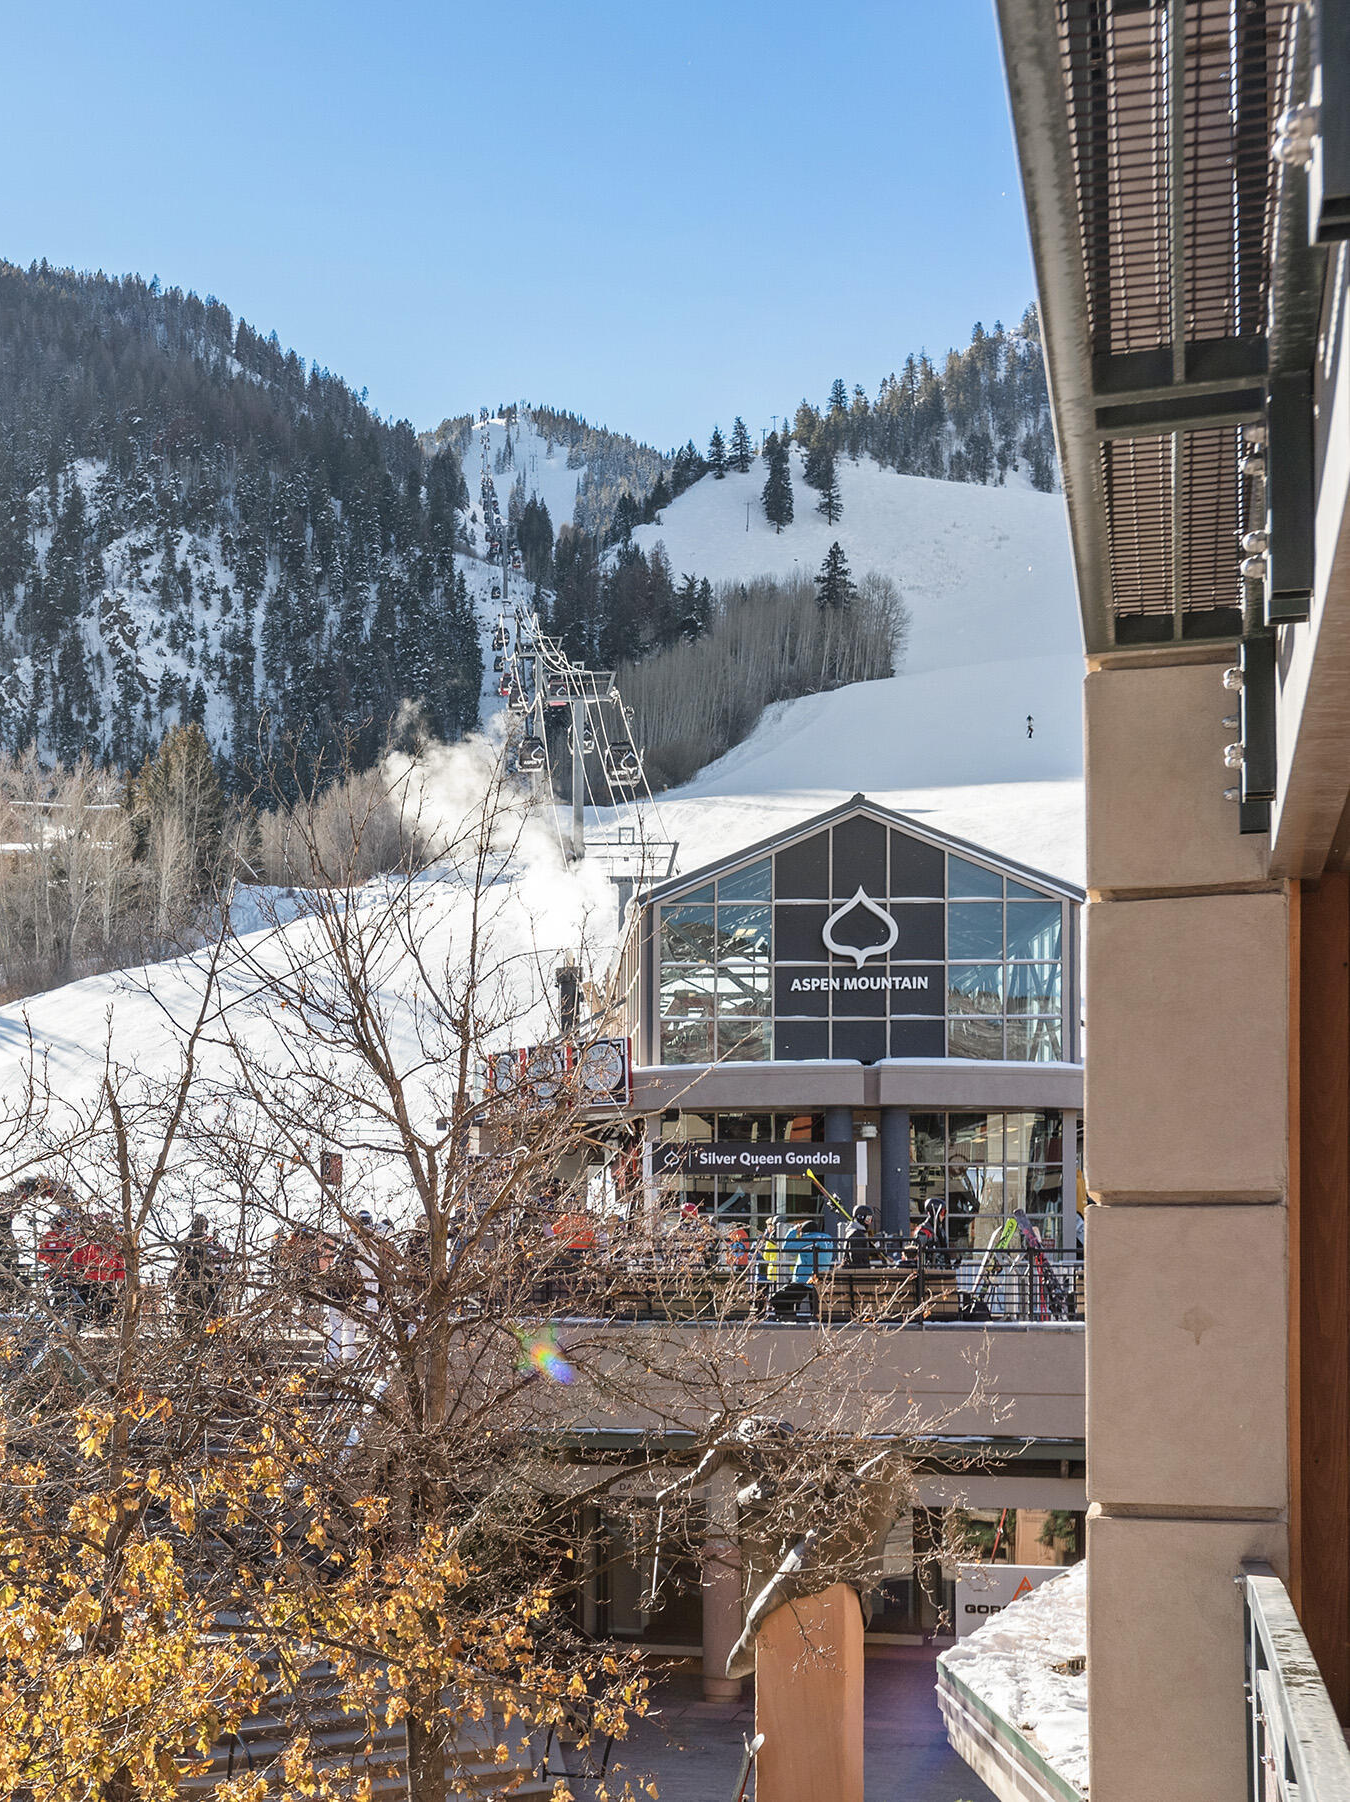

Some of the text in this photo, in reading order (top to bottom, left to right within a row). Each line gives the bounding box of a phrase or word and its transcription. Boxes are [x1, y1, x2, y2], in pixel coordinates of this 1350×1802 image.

[790, 976, 929, 991] ASPEN MOUNTAIN
[700, 1152, 841, 1167] Silver Queen Gondola
